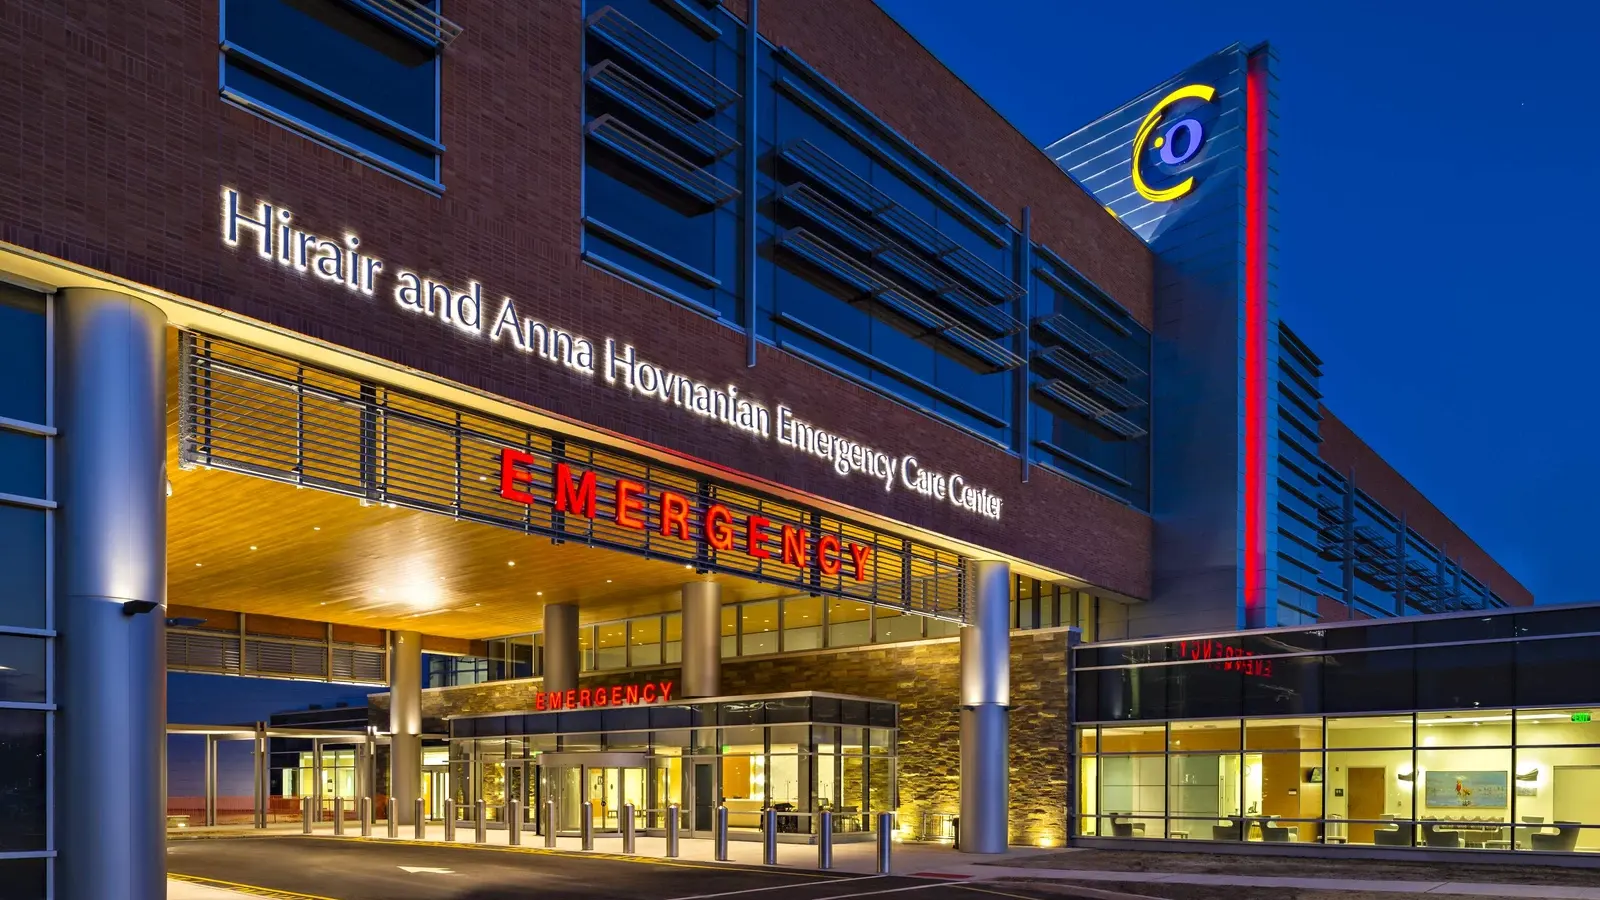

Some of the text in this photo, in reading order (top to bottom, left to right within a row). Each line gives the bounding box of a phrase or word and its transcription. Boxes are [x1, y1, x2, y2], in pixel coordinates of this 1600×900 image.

[221, 184, 1004, 520] Hirair and Anna Hovnanian Emergency Care Center
[500, 447, 872, 582] EMERGENCY
[535, 682, 673, 711] EMERGENCY
